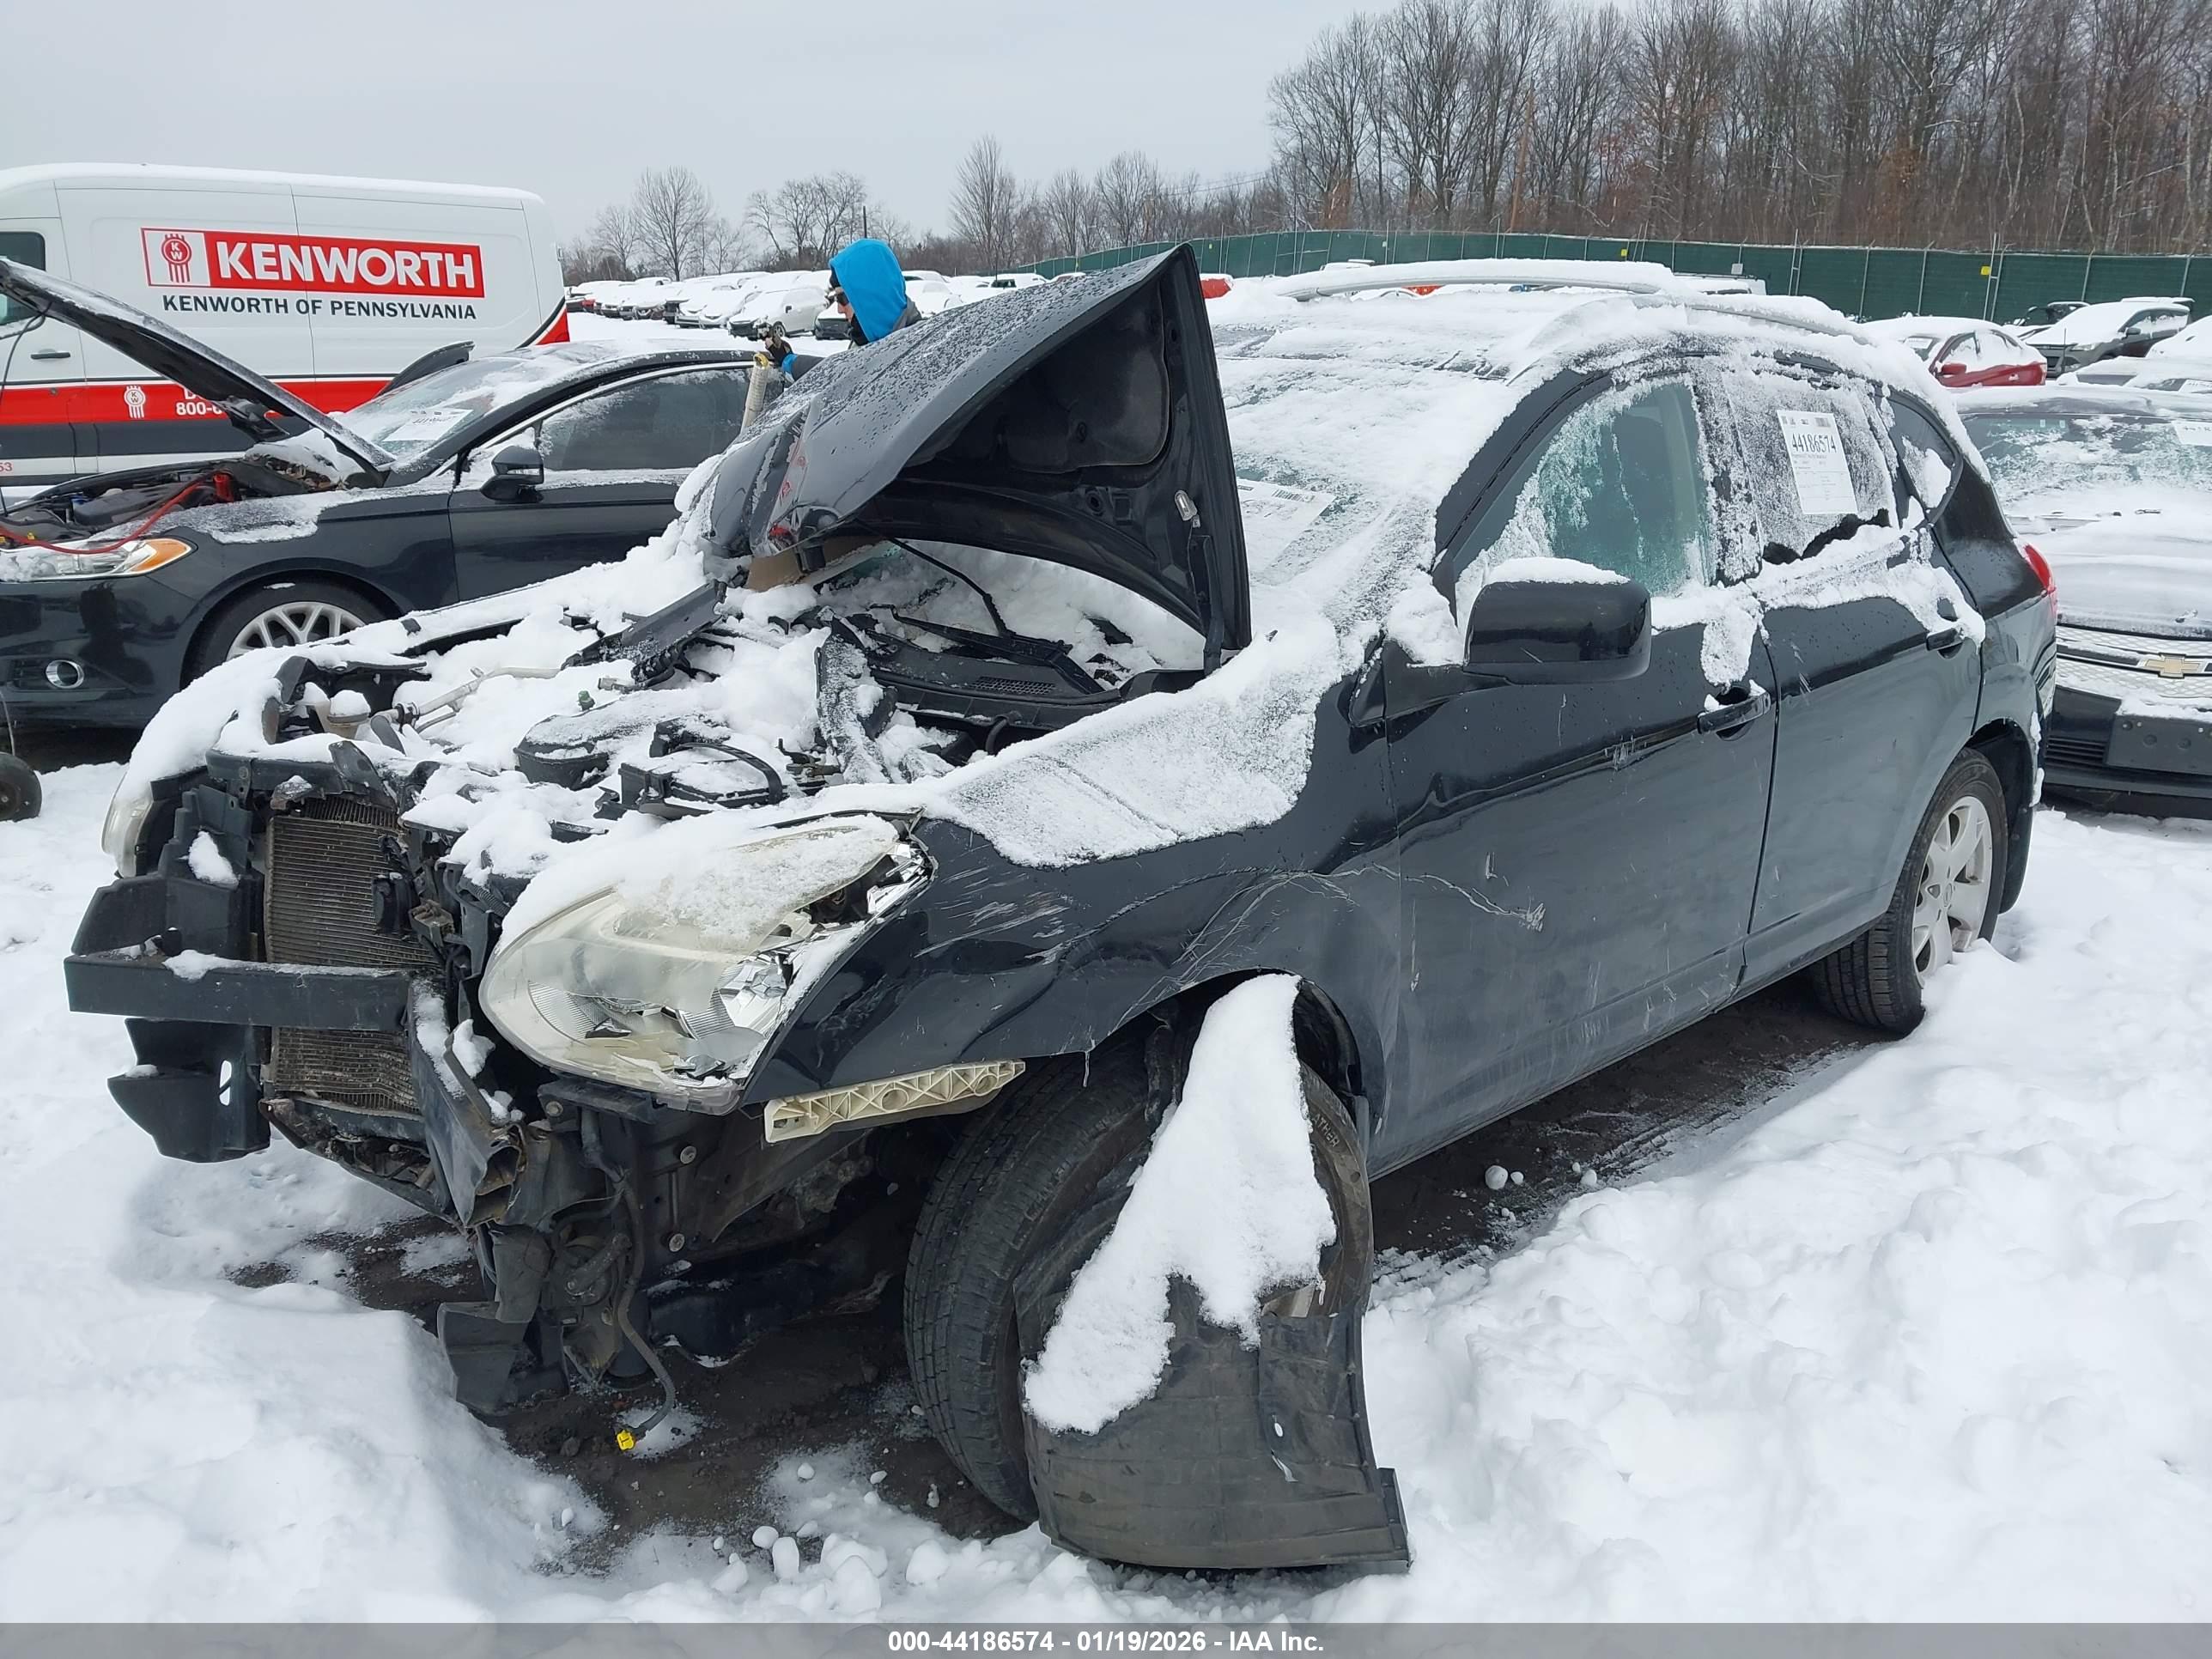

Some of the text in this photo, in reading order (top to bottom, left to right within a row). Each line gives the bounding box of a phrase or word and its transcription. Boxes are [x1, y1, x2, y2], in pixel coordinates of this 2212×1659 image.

[216, 240, 475, 289] KENWORTH
[162, 295, 477, 319] KENWORTH OF PENNSYLVANIA
[1791, 433, 1838, 453] 44186574
